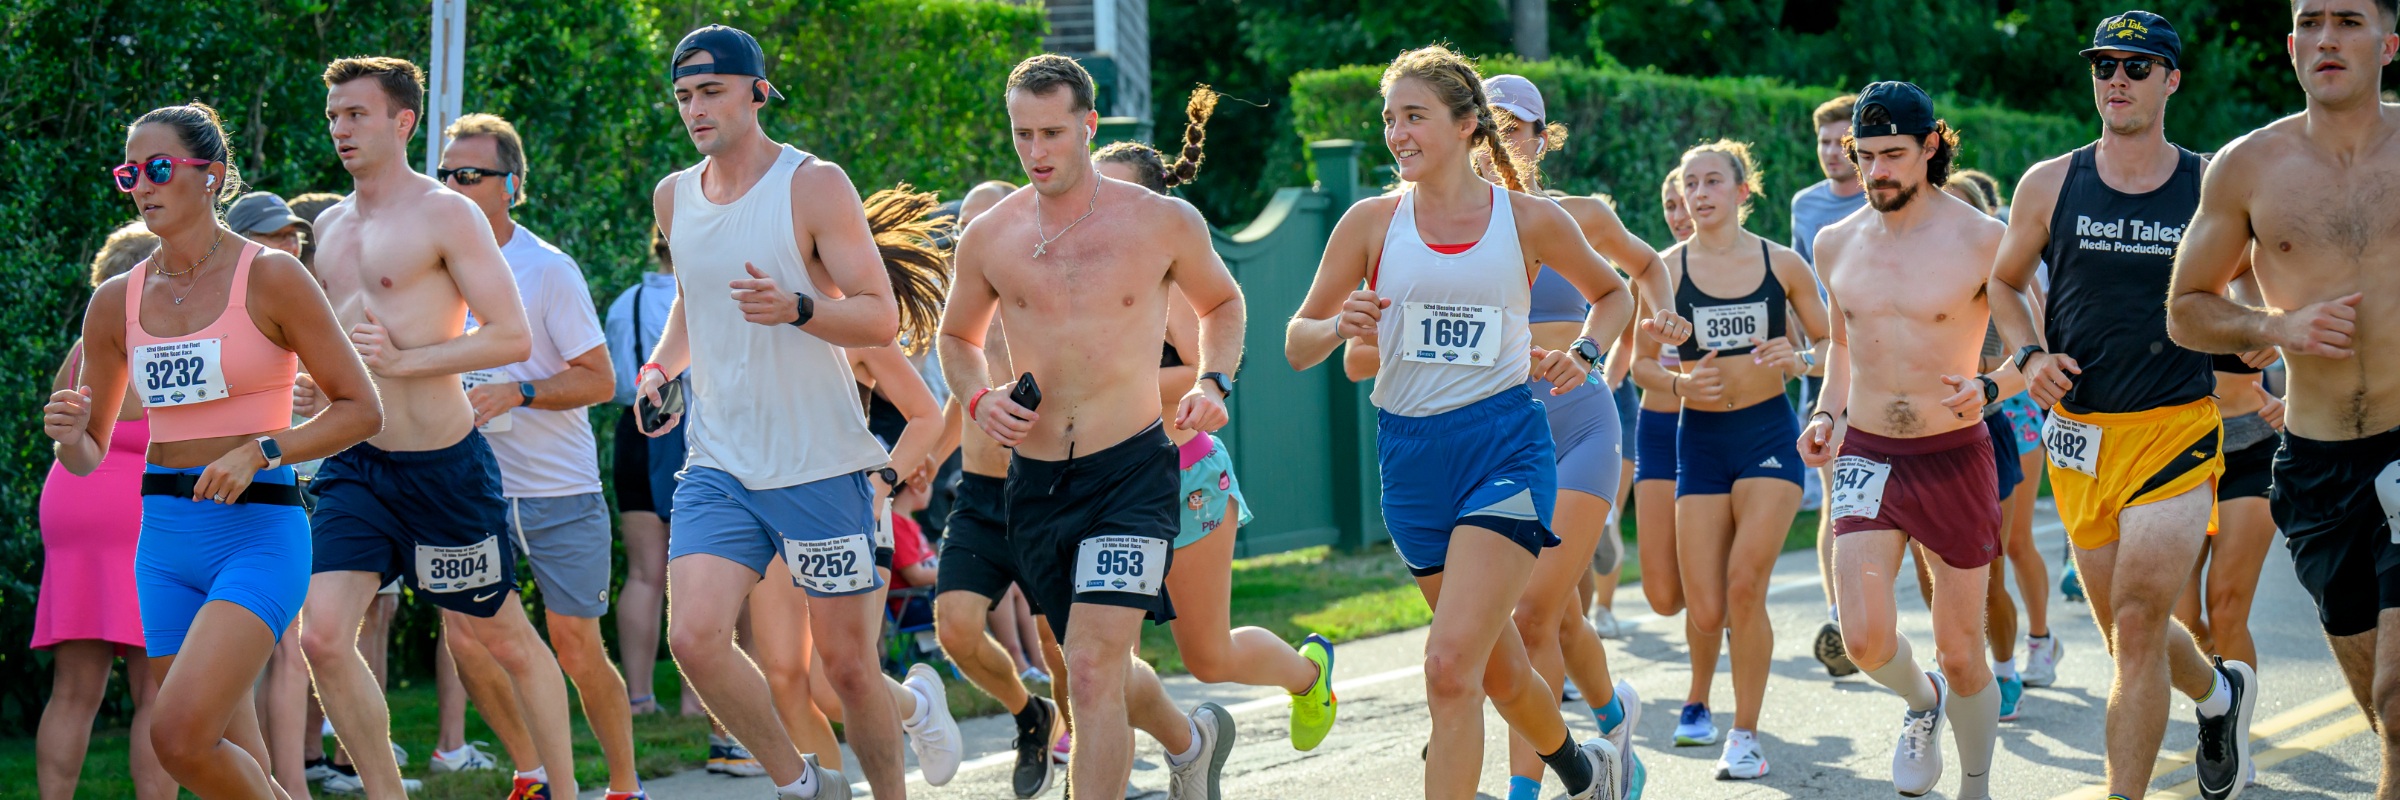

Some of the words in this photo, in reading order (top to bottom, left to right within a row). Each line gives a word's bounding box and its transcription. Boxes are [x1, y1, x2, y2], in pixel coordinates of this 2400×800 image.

[2107, 19, 2126, 31] Reel
[2127, 19, 2148, 34] Tales
[2076, 215, 2124, 239] Reel
[2079, 239, 2111, 251] Media
[2114, 242, 2171, 255] Production
[1421, 318, 1486, 348] 1697
[1707, 315, 1755, 338] 3306
[146, 356, 206, 390] 3232
[2048, 425, 2087, 461] 2482
[431, 553, 488, 579] 3804
[798, 550, 858, 578] 2252
[1097, 550, 1144, 576] 953
